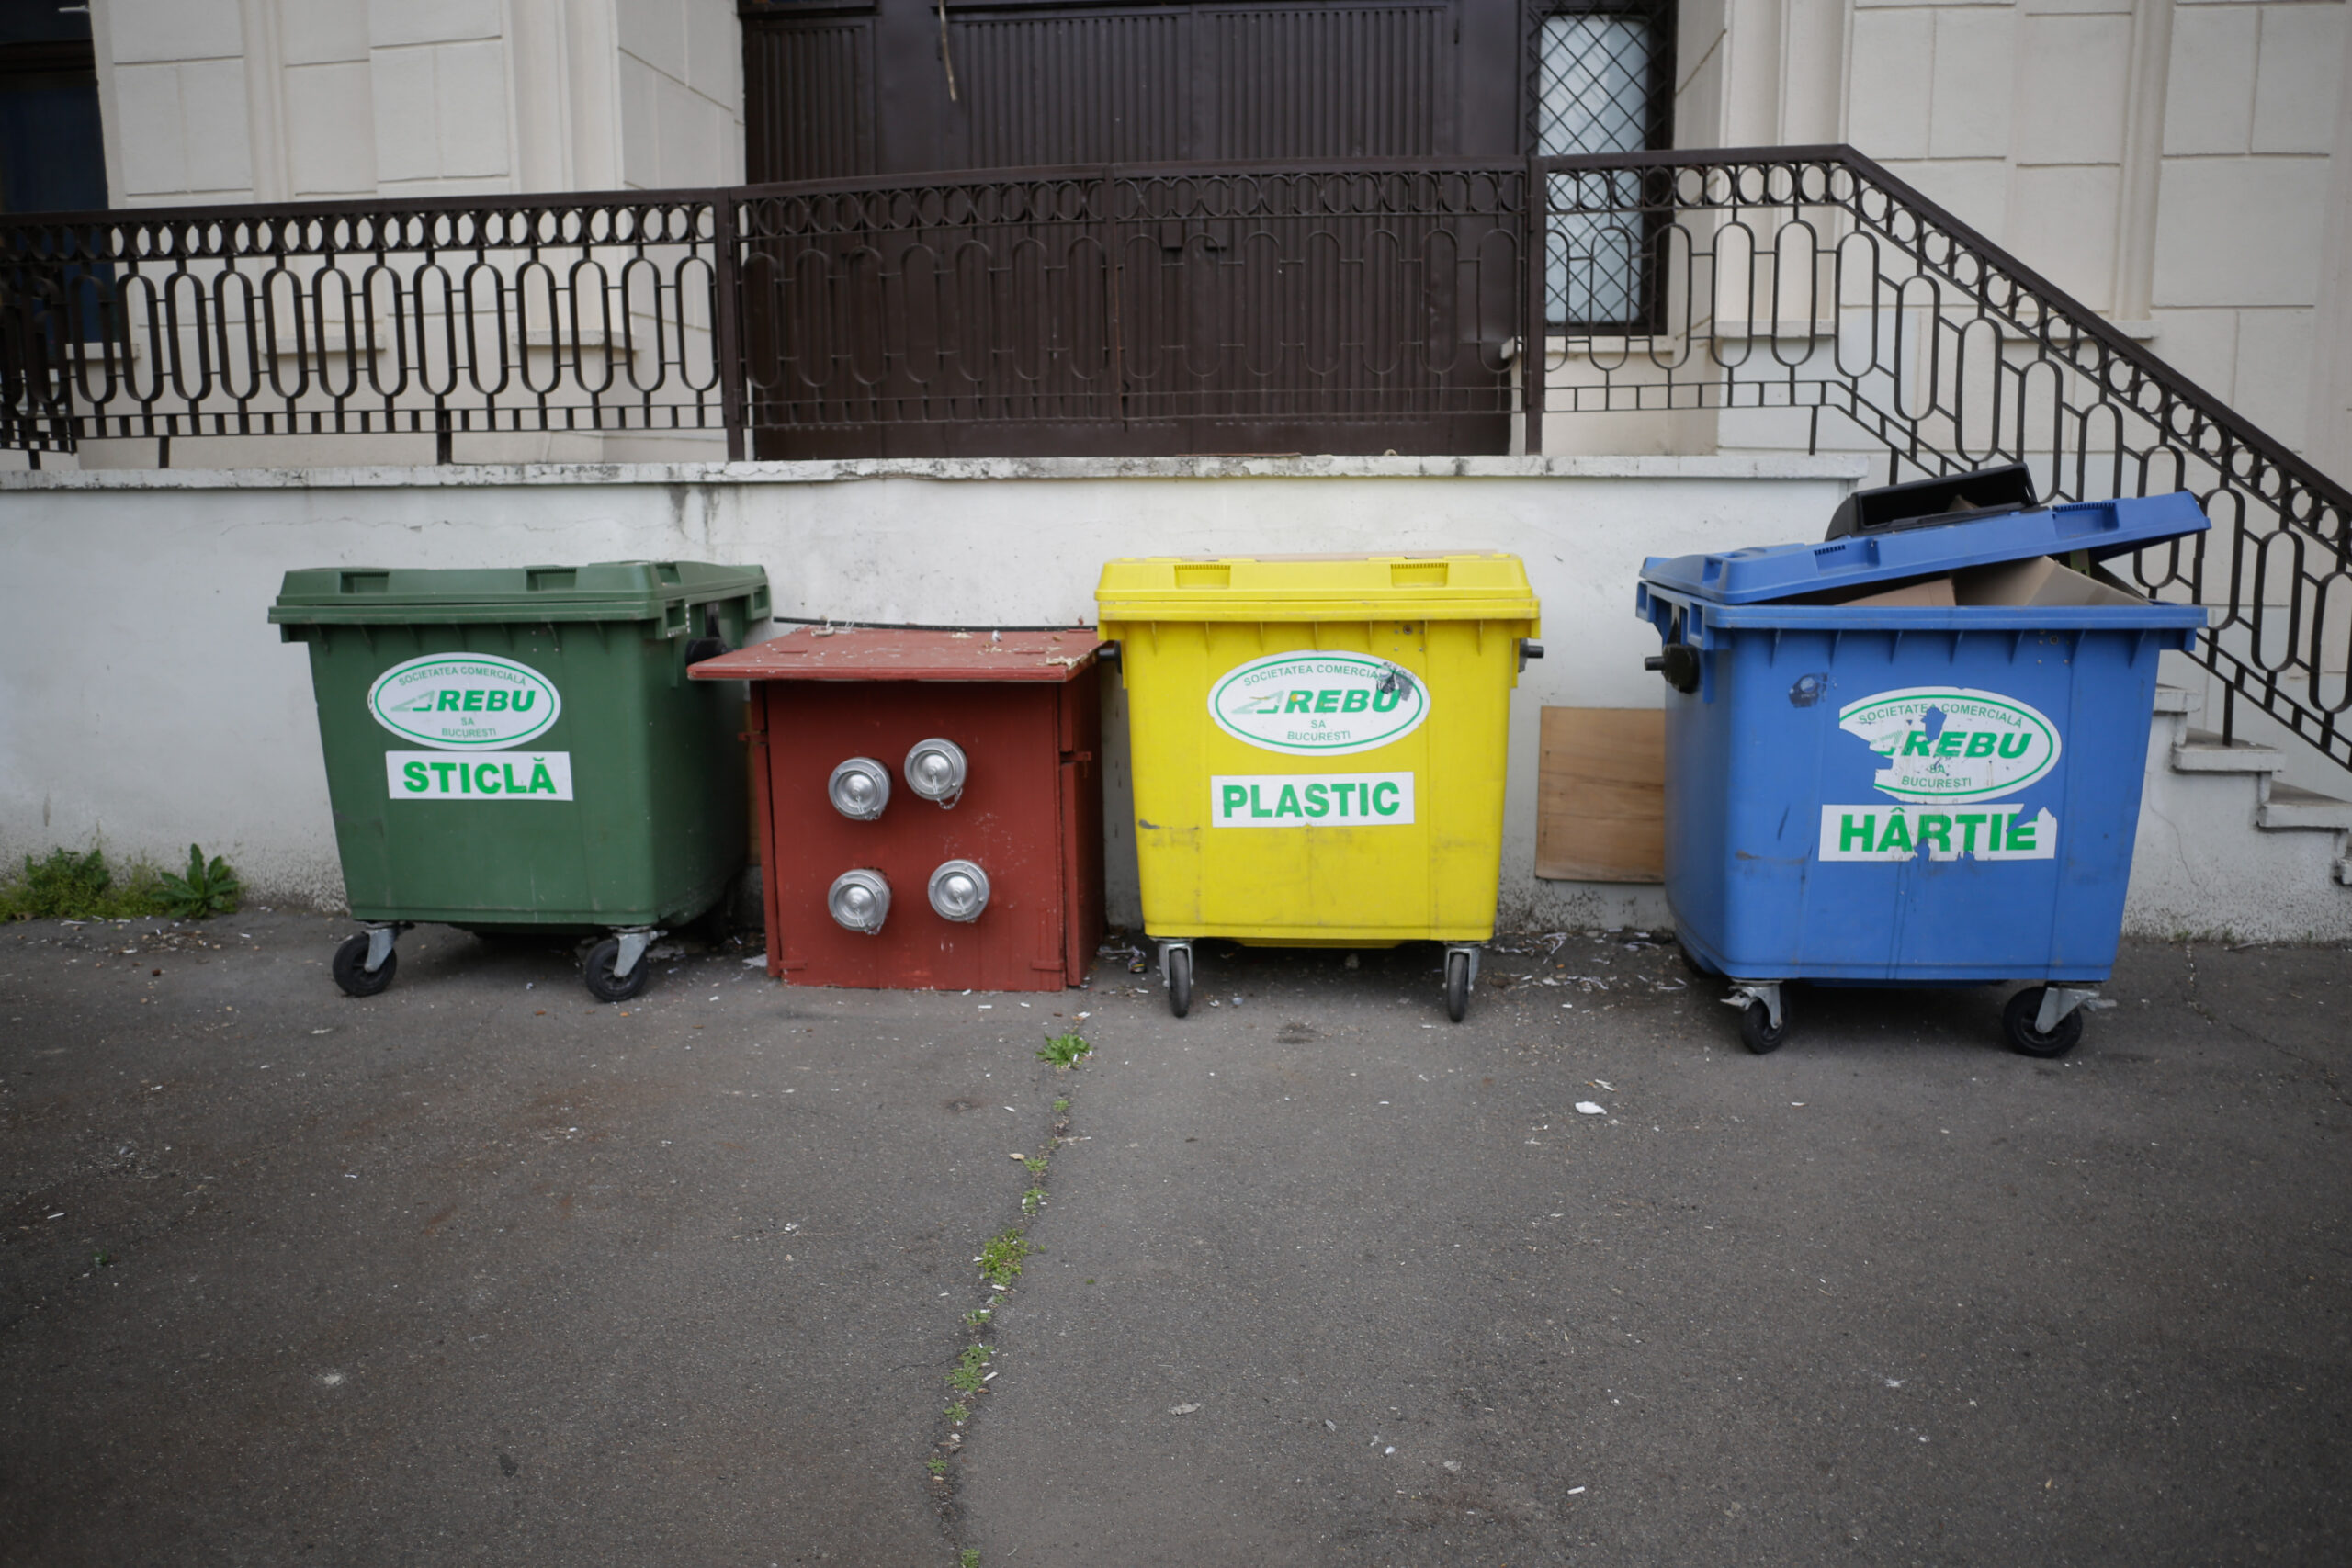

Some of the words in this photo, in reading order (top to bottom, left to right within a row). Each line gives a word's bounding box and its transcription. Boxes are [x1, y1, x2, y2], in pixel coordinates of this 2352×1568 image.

[399, 666, 458, 686] SOCIETATEA
[1243, 666, 1314, 687] SOCIETATEA
[436, 690, 536, 712] REBU
[1284, 689, 1401, 714] REBU
[460, 717, 474, 726] SA
[1311, 719, 1327, 728] SA
[1858, 703, 1936, 724] SOCIETATE
[1901, 730, 2033, 759] REBU
[403, 757, 557, 794] STICLĂ
[1222, 781, 1400, 818] PLASTIC
[1838, 807, 2039, 852] HÂRTIE
